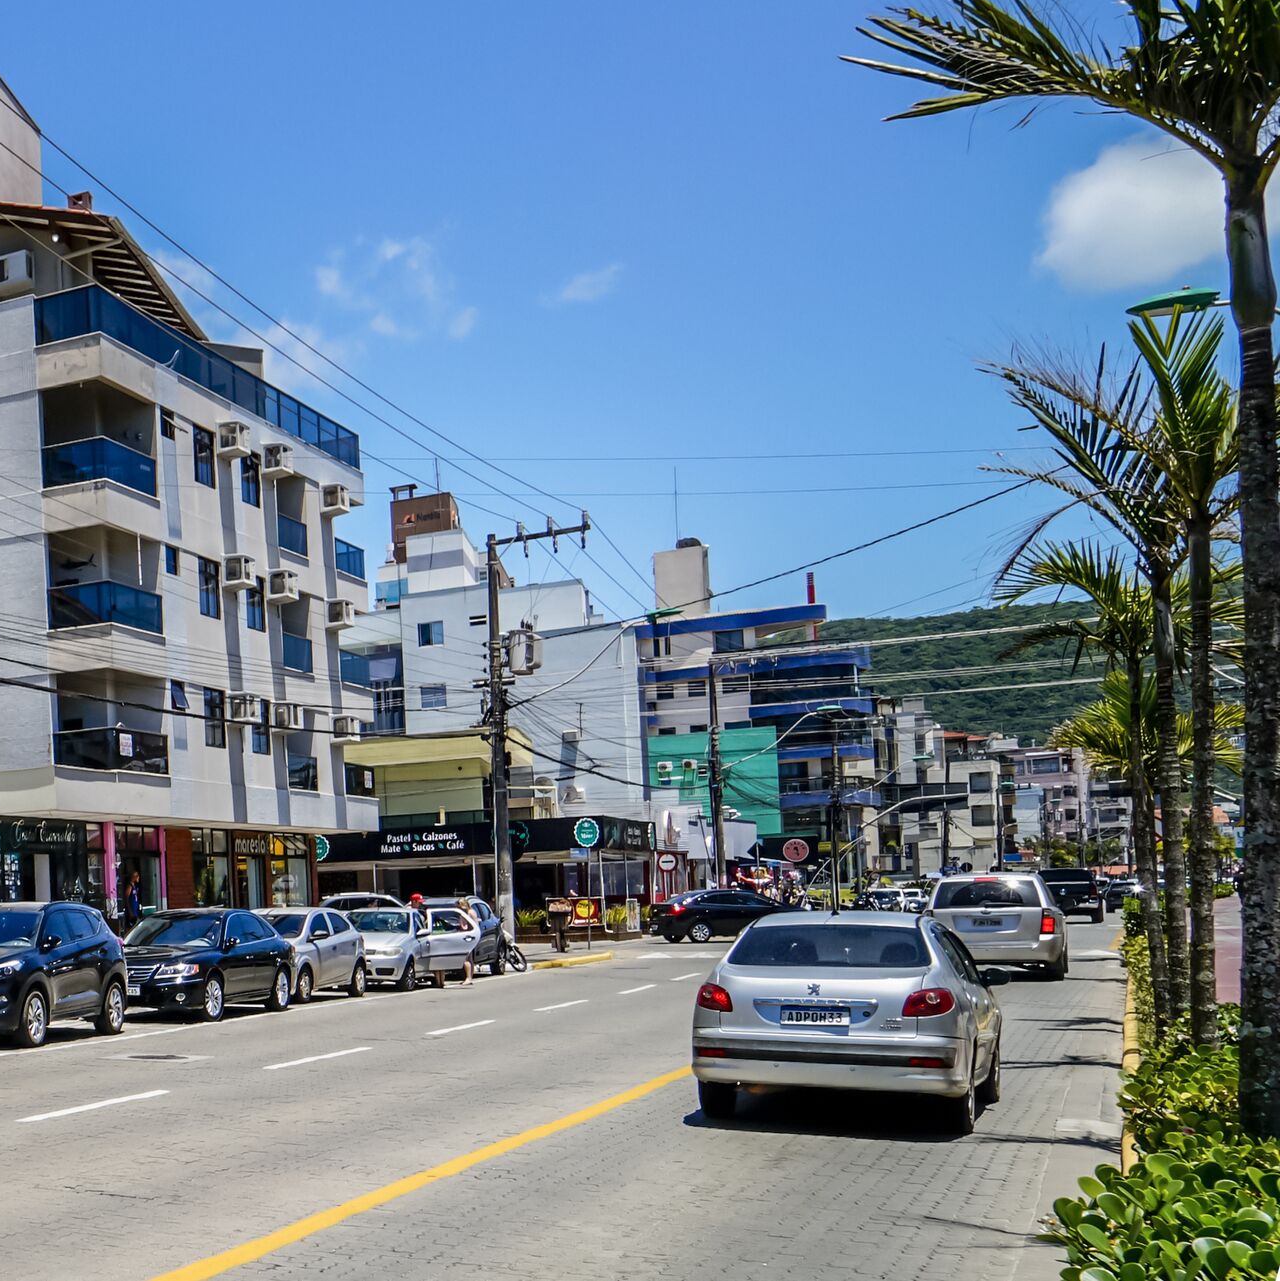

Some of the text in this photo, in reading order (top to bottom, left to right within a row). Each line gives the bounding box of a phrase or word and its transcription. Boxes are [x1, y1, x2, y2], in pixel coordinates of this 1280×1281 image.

[386, 831, 458, 844] Pastel Calzones
[380, 840, 465, 854] Mate Sucos Café
